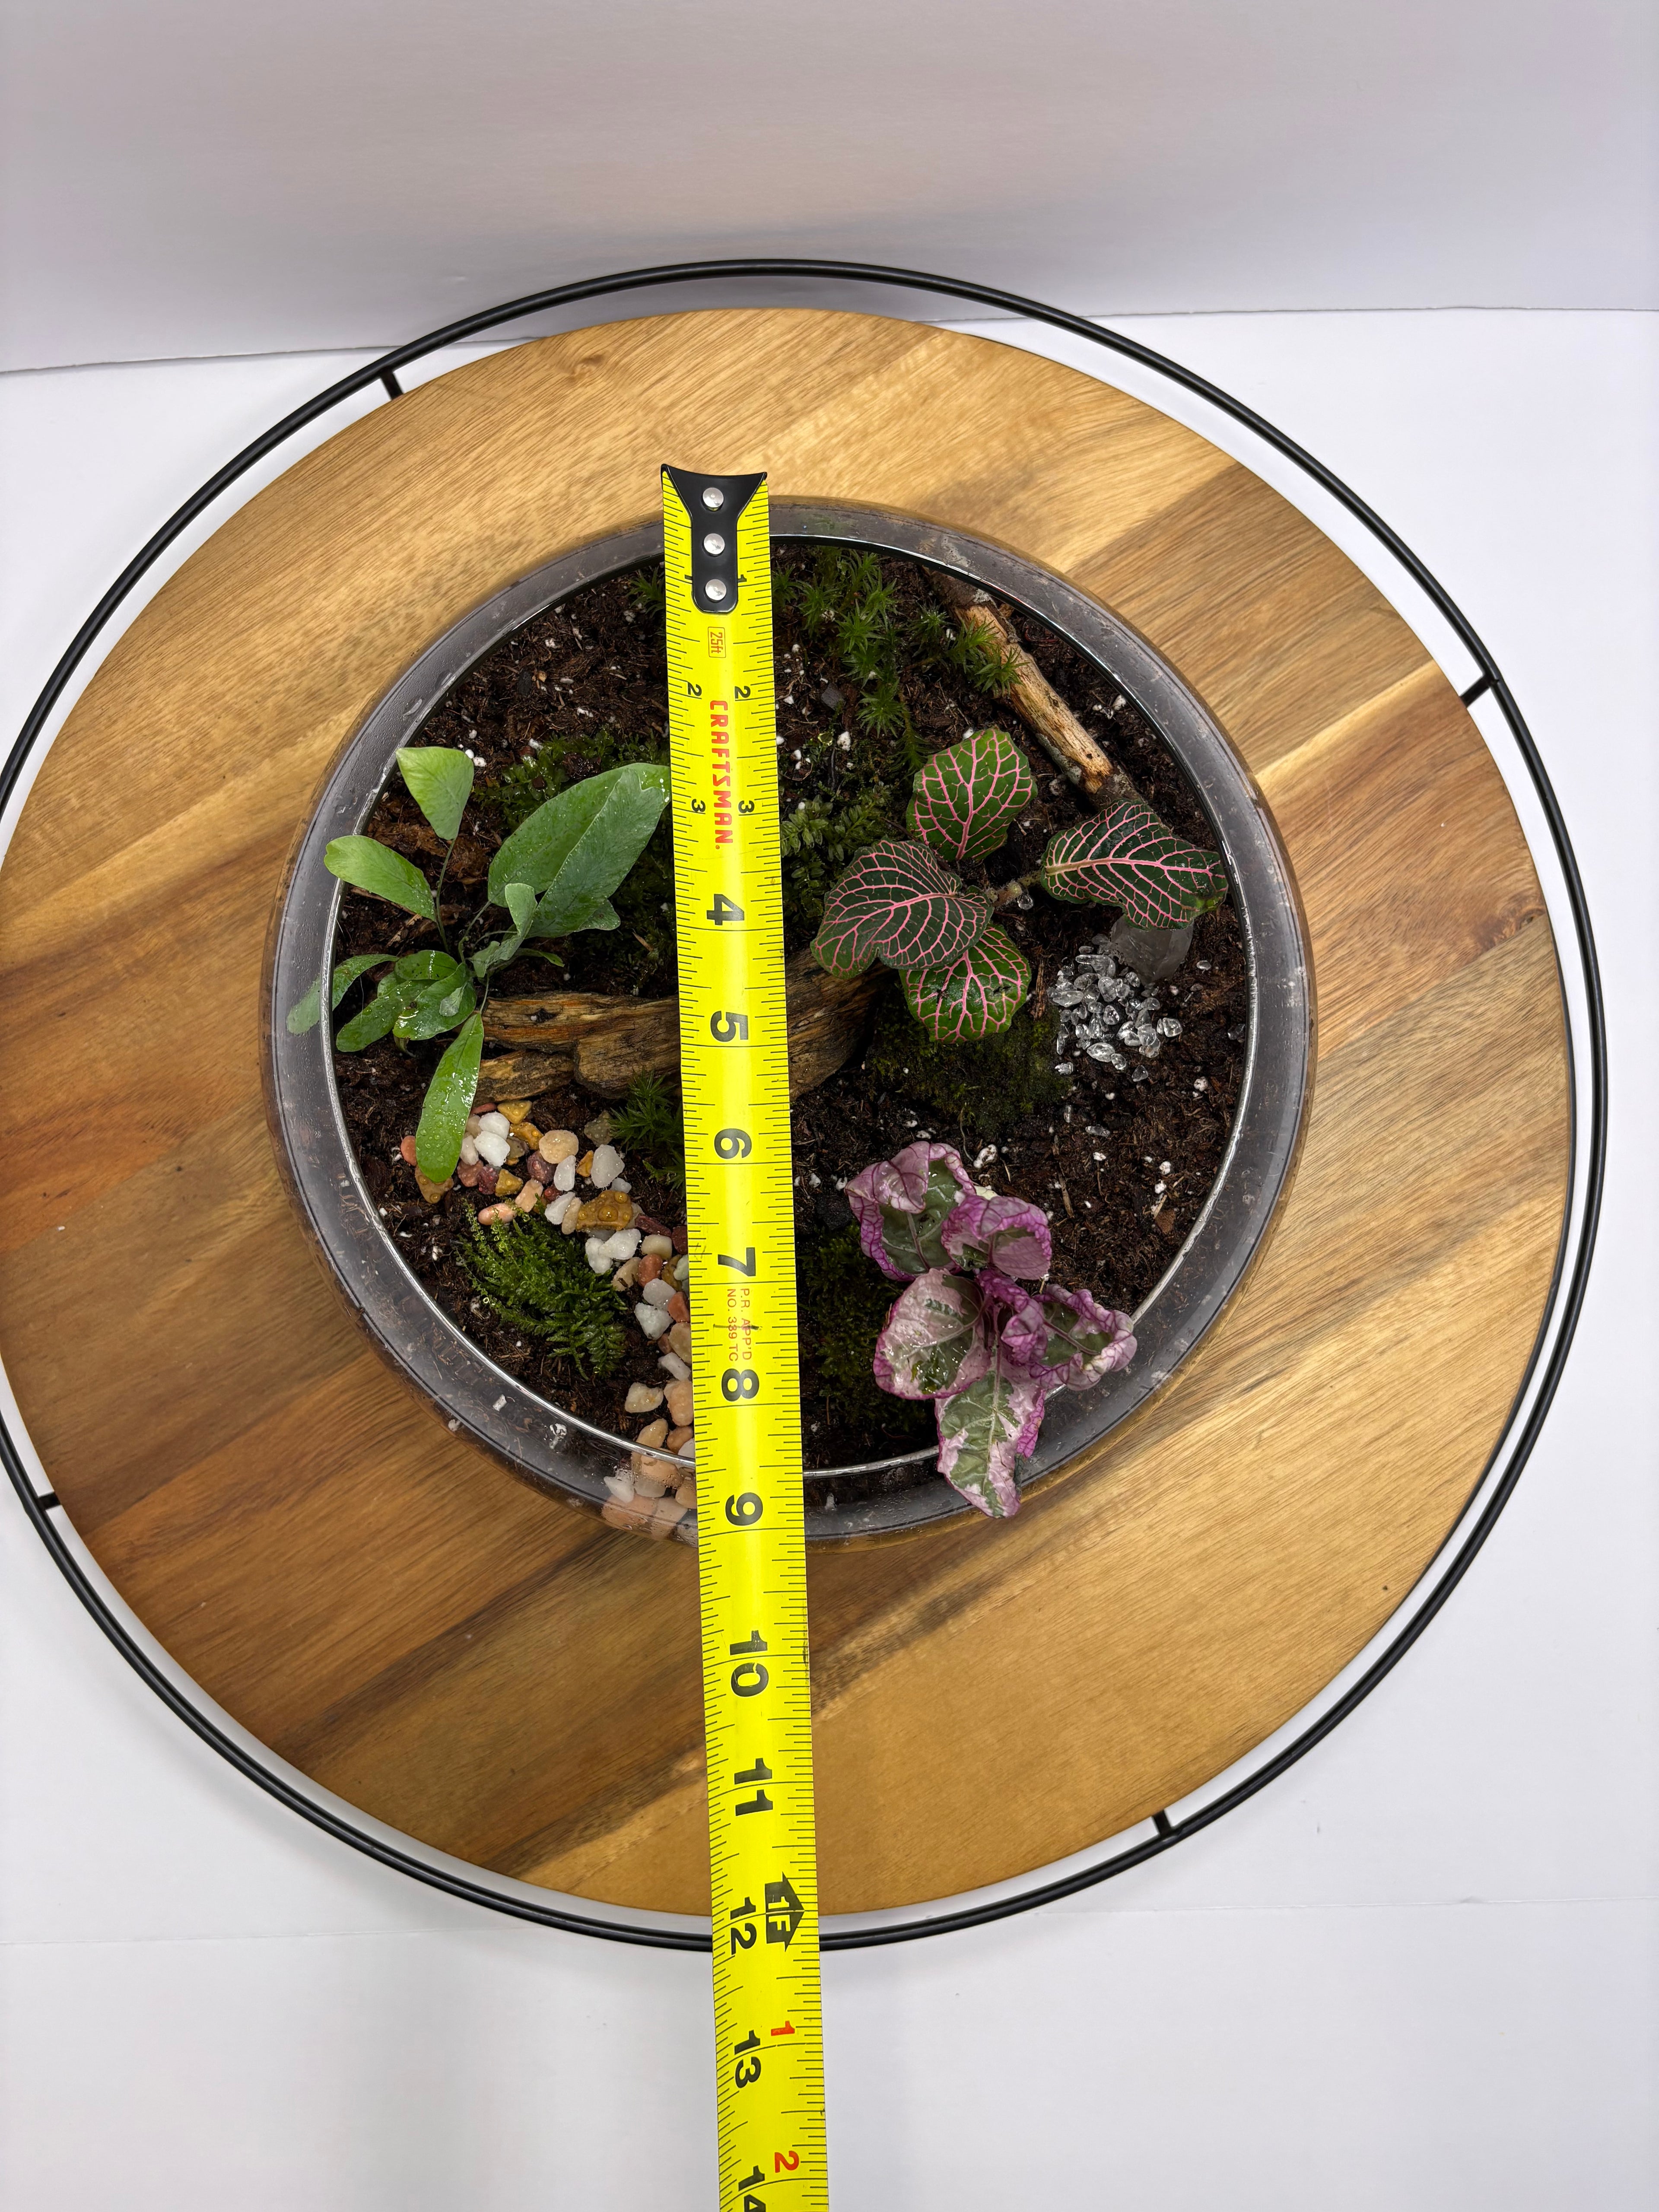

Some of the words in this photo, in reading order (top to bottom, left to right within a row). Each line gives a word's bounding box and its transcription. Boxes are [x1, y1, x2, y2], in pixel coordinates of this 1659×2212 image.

[710, 632, 723, 654] 25ft
[688, 681, 702, 696] 2
[735, 686, 750, 699] 2
[691, 798, 706, 813] 3
[738, 801, 755, 814] 3
[706, 893, 745, 925] 4
[710, 1011, 749, 1042] 5
[714, 1128, 752, 1159] 6
[718, 1247, 756, 1277] 7
[727, 1289, 736, 1312] NO.
[740, 1288, 750, 1312] P.R.
[728, 1316, 737, 1339] 339
[741, 1318, 752, 1360] APP'D
[729, 1344, 738, 1361] TC
[721, 1368, 760, 1402] 8
[725, 1492, 763, 1526] 9
[729, 1630, 769, 1697] 10
[734, 1758, 773, 1816] 11
[730, 1897, 757, 1955] 12
[767, 1895, 790, 1932] 1F
[770, 2020, 795, 2036] 1
[734, 2029, 761, 2088] 13
[775, 2150, 799, 2173] 2
